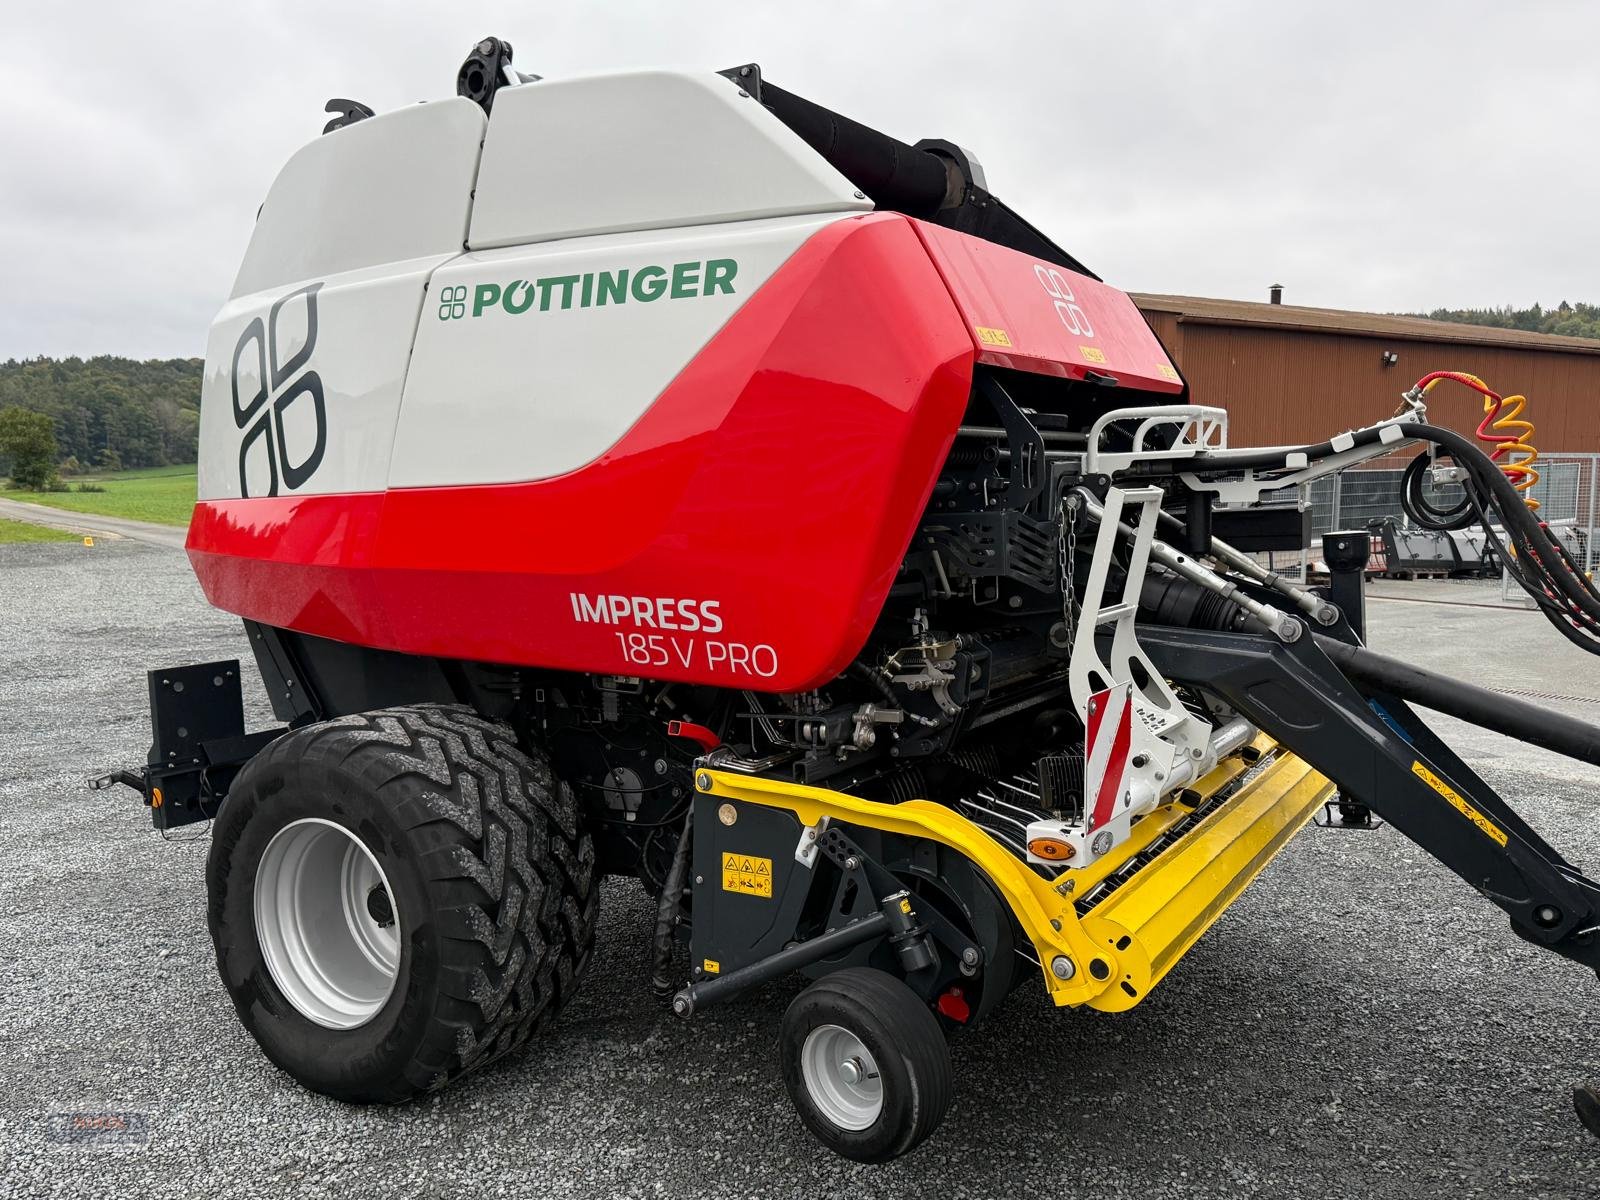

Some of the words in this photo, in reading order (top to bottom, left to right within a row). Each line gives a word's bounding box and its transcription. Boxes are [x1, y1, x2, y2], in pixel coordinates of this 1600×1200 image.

[472, 258, 738, 318] PÖTTINGER
[570, 592, 723, 633] IMPRESS
[705, 641, 778, 677] PRO
